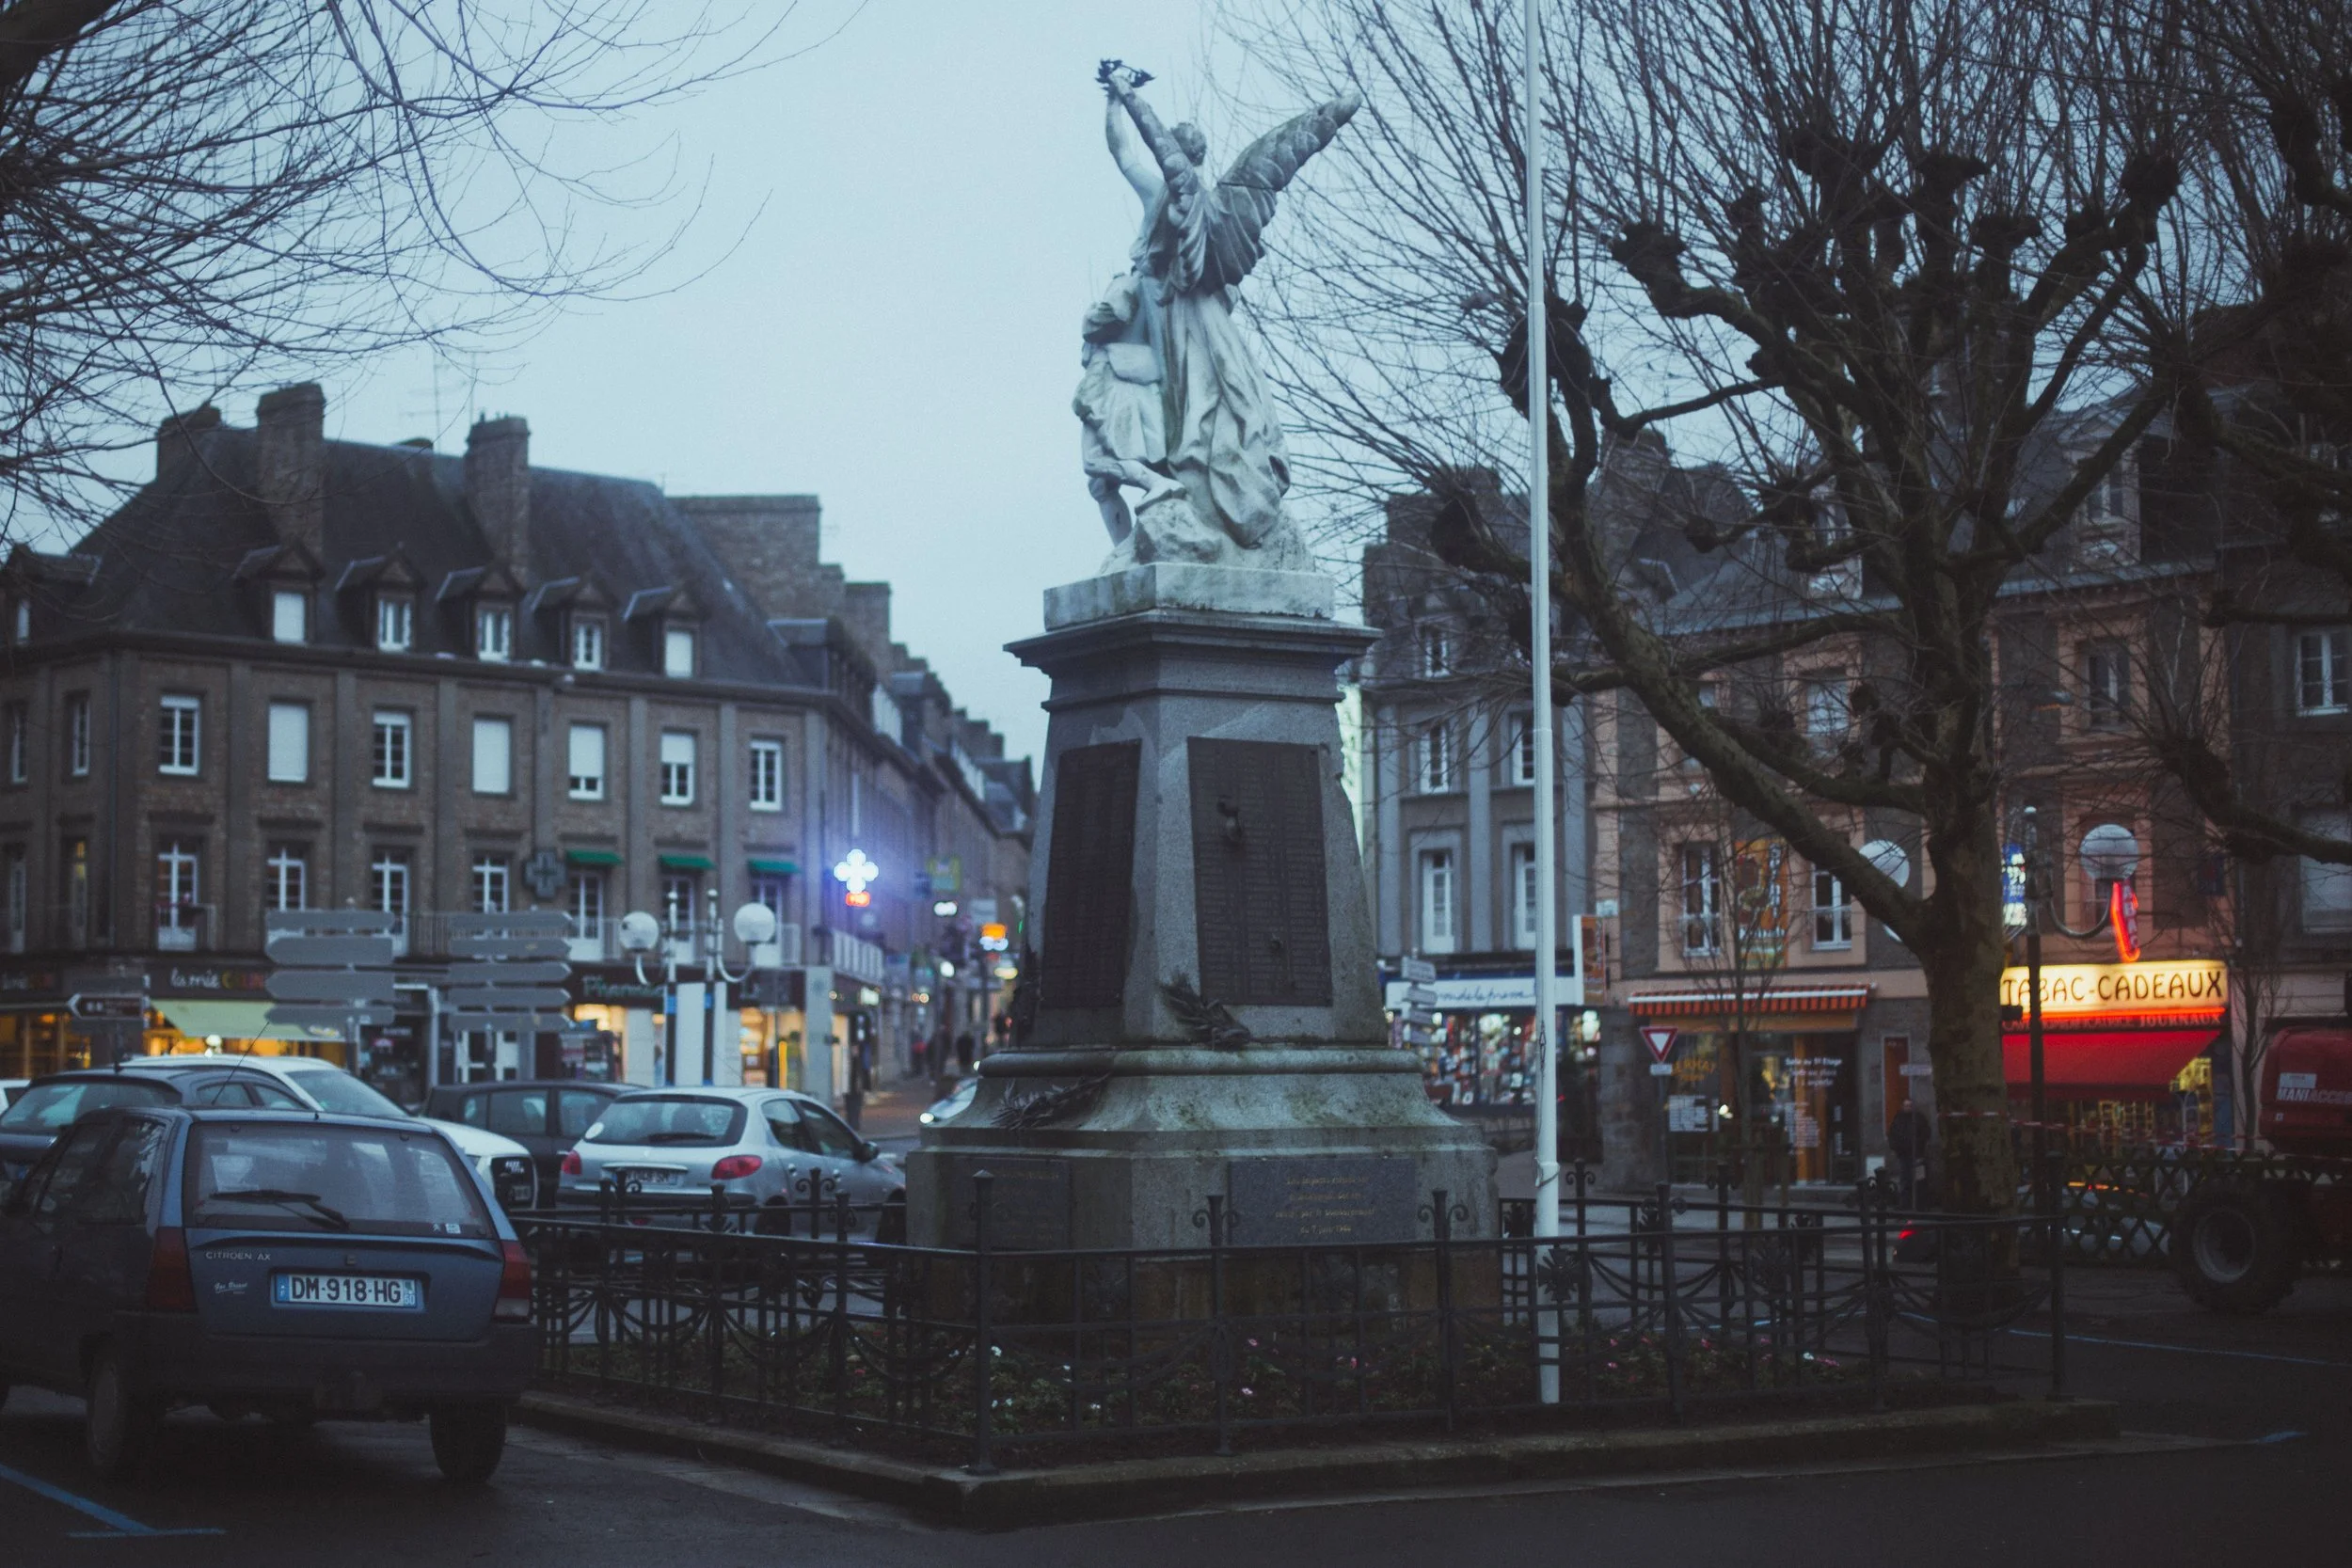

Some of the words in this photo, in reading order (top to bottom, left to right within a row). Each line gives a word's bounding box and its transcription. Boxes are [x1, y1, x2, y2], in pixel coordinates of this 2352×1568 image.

[2139, 1013, 2220, 1028] JOURNAUX
[205, 1250, 252, 1261] CITROEN
[255, 1252, 272, 1261] AX
[291, 1276, 402, 1304] DM-918-HG
